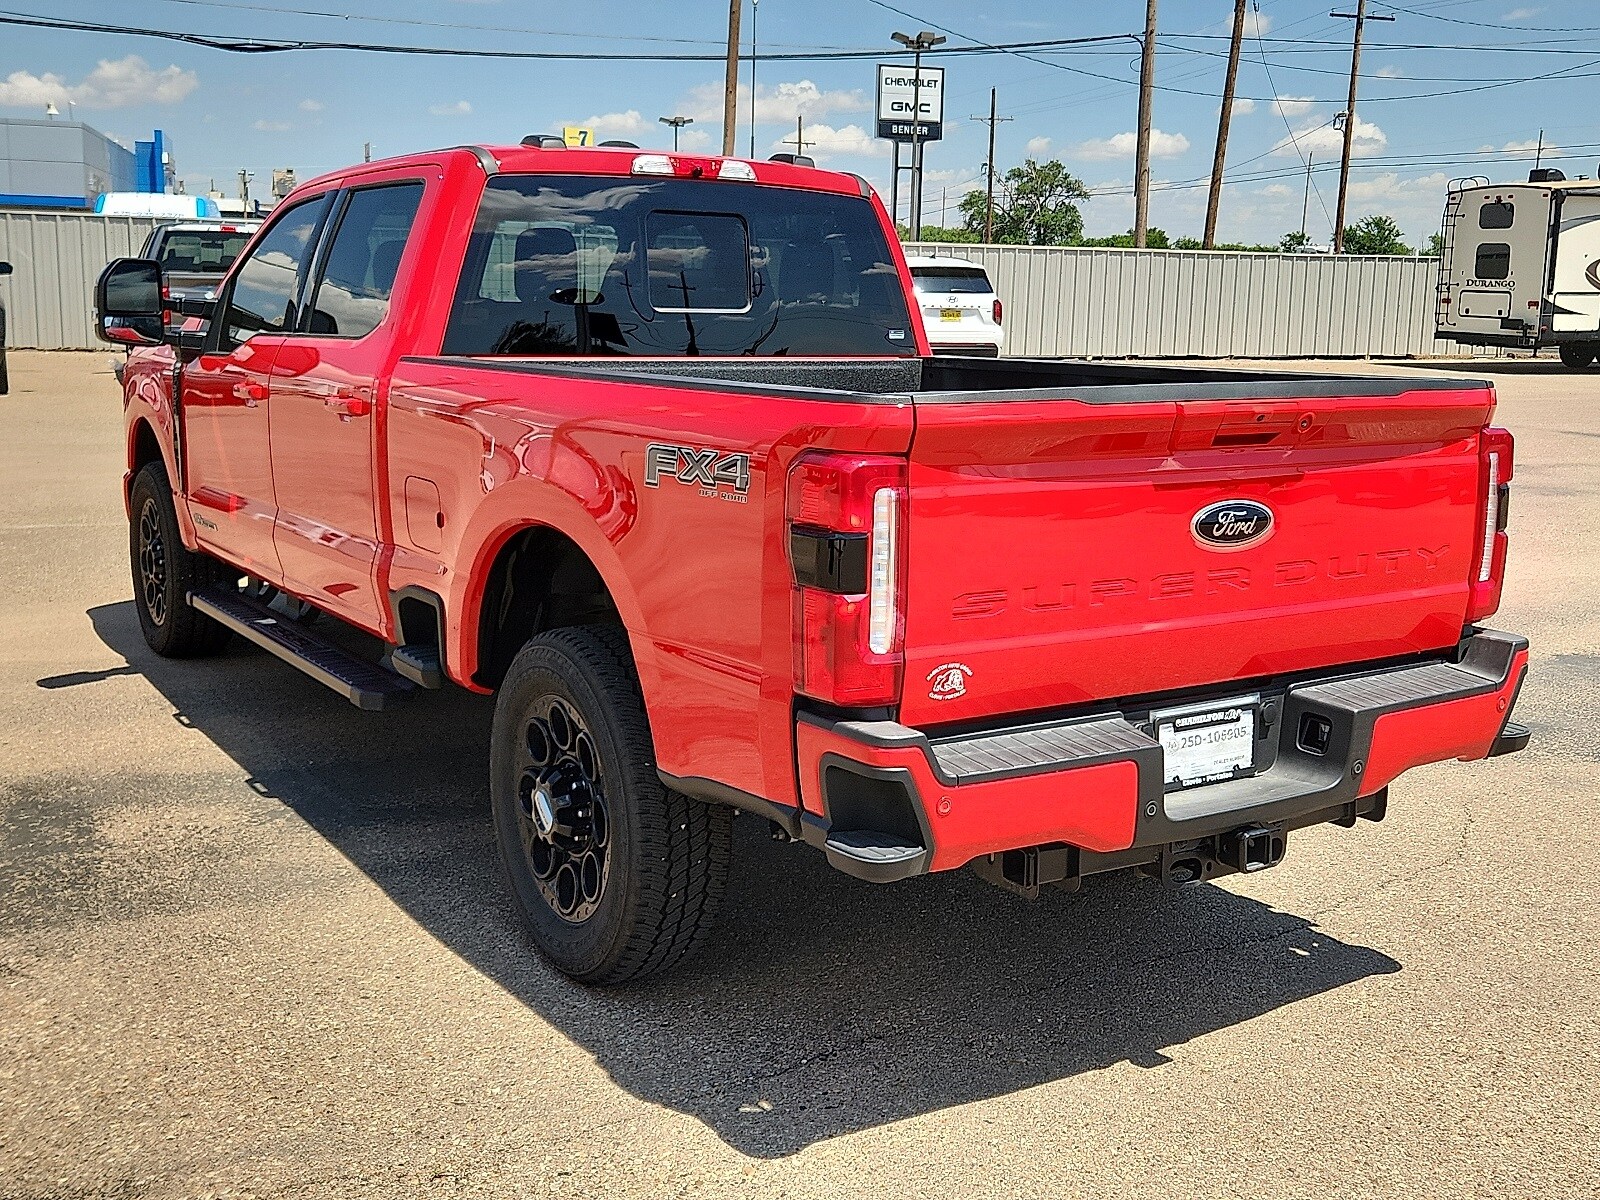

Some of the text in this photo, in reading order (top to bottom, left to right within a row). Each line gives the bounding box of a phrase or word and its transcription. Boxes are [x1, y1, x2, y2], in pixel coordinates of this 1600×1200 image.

[891, 102, 930, 113] GMC
[1466, 279, 1515, 288] DURANGO
[644, 442, 750, 493] FX4
[699, 489, 748, 503] OFF ROAD
[1213, 510, 1257, 537] Ford
[951, 544, 1450, 621] SUPER DUTY
